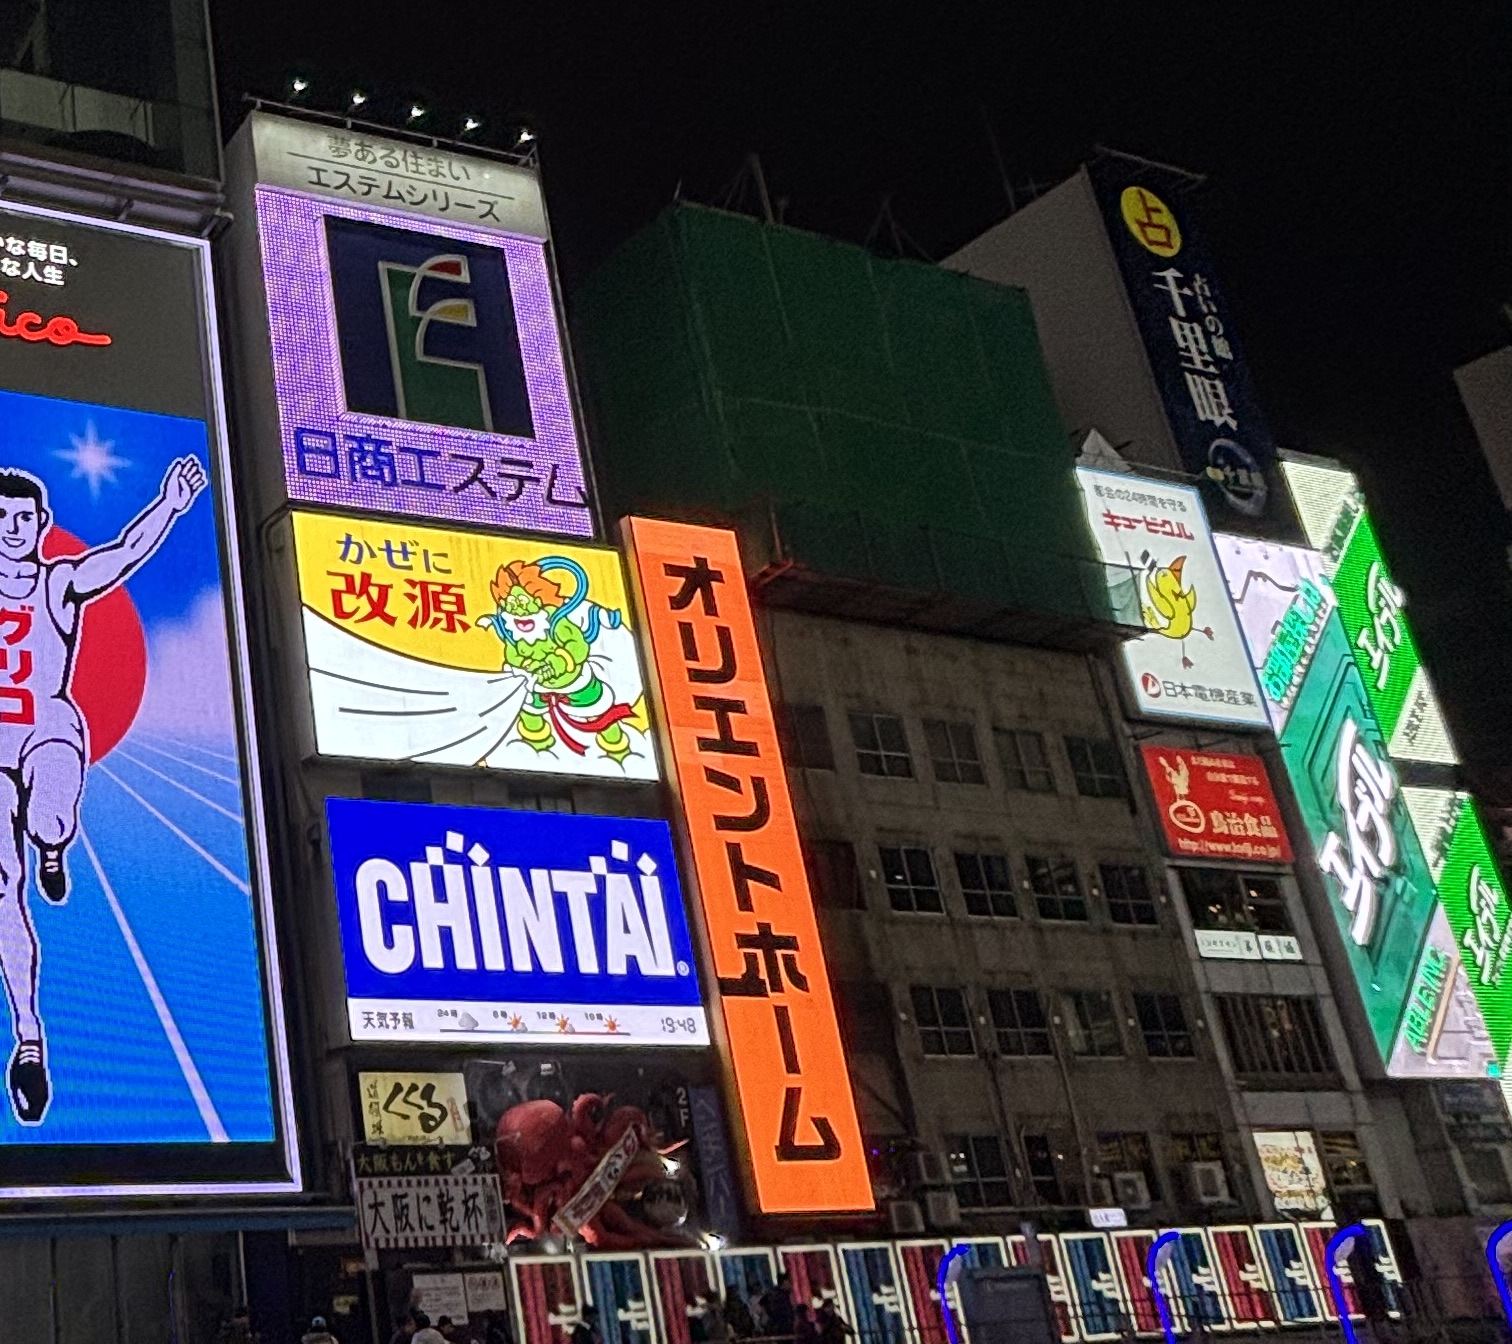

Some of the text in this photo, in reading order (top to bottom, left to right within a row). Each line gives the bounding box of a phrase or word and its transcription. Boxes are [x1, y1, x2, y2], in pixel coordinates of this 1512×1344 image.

[326, 133, 472, 184] 夢ある住まい
[307, 165, 502, 223] エステムシリーズ
[293, 426, 590, 510] 日商エステム
[336, 532, 454, 576] かぜに
[325, 570, 472, 635] 改源
[662, 554, 844, 1164] オリエントホーム
[362, 1010, 416, 1032] 天気予報
[382, 1081, 449, 1135] くくる
